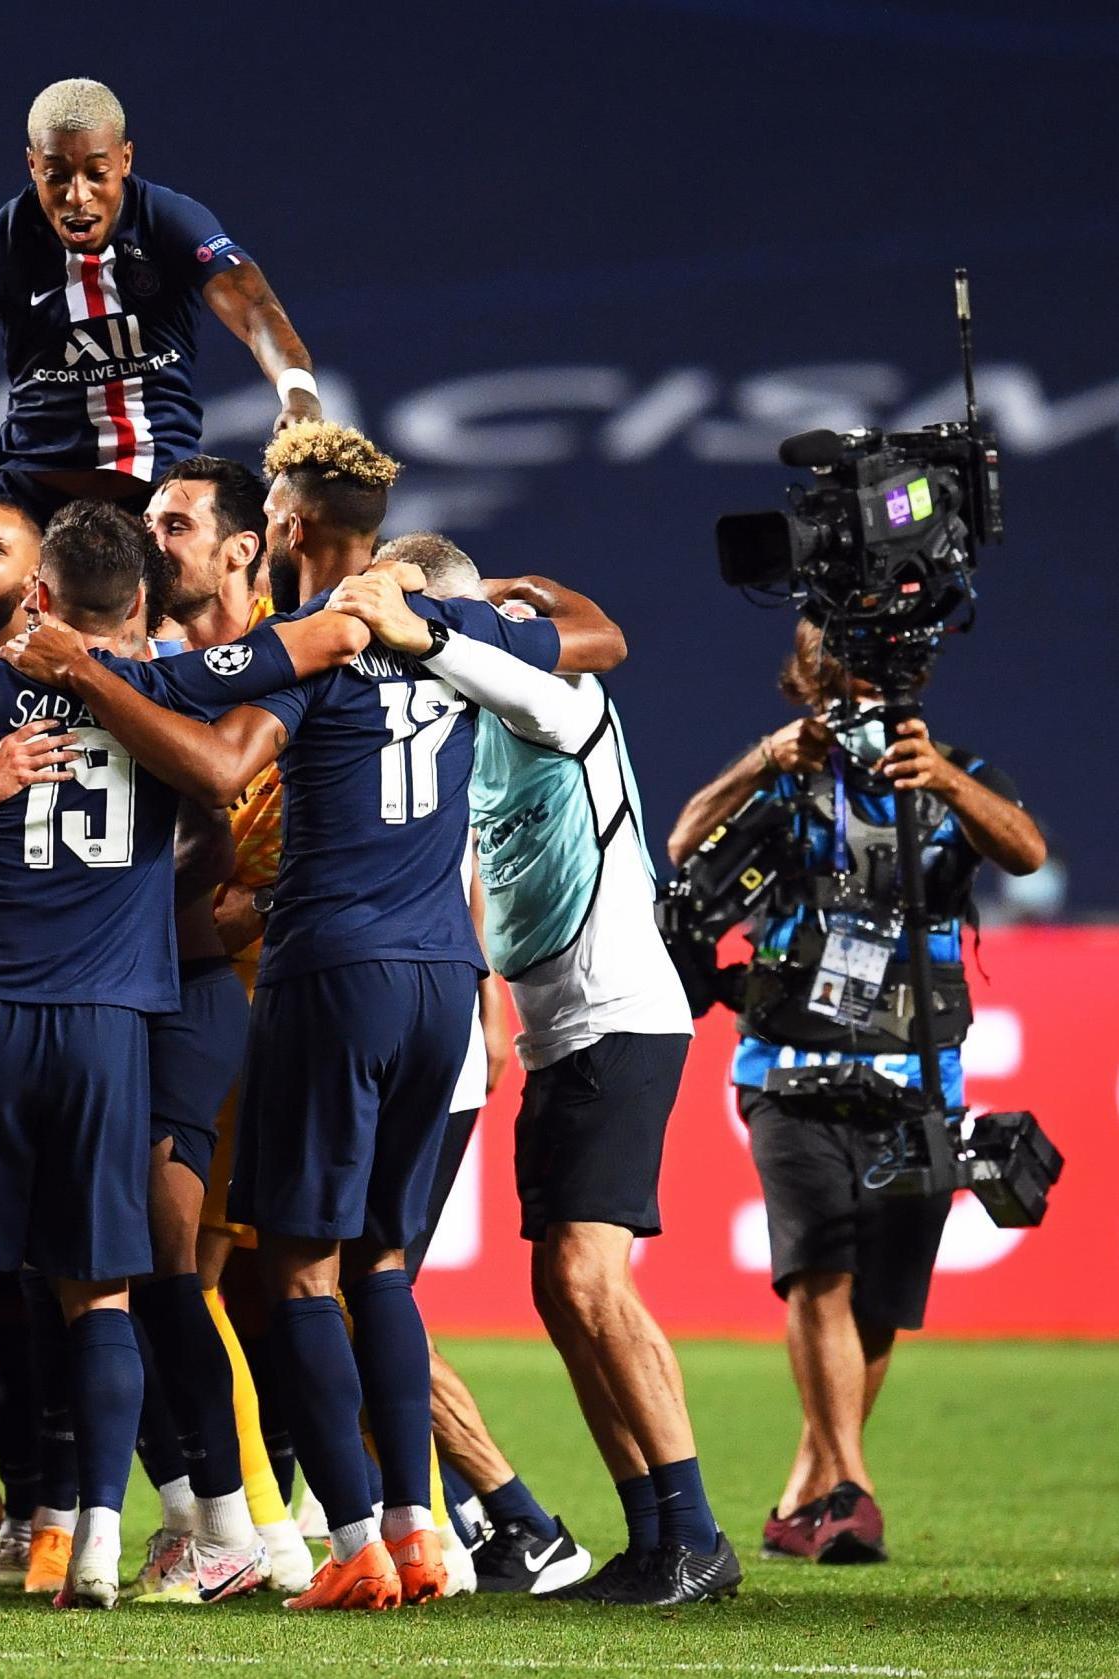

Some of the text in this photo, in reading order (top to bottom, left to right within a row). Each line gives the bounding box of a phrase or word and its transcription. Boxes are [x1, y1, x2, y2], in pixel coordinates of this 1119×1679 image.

[82, 364, 116, 382] LIVE
[9, 689, 96, 729] SARA
[378, 679, 467, 825] 17
[24, 726, 136, 870] 19
